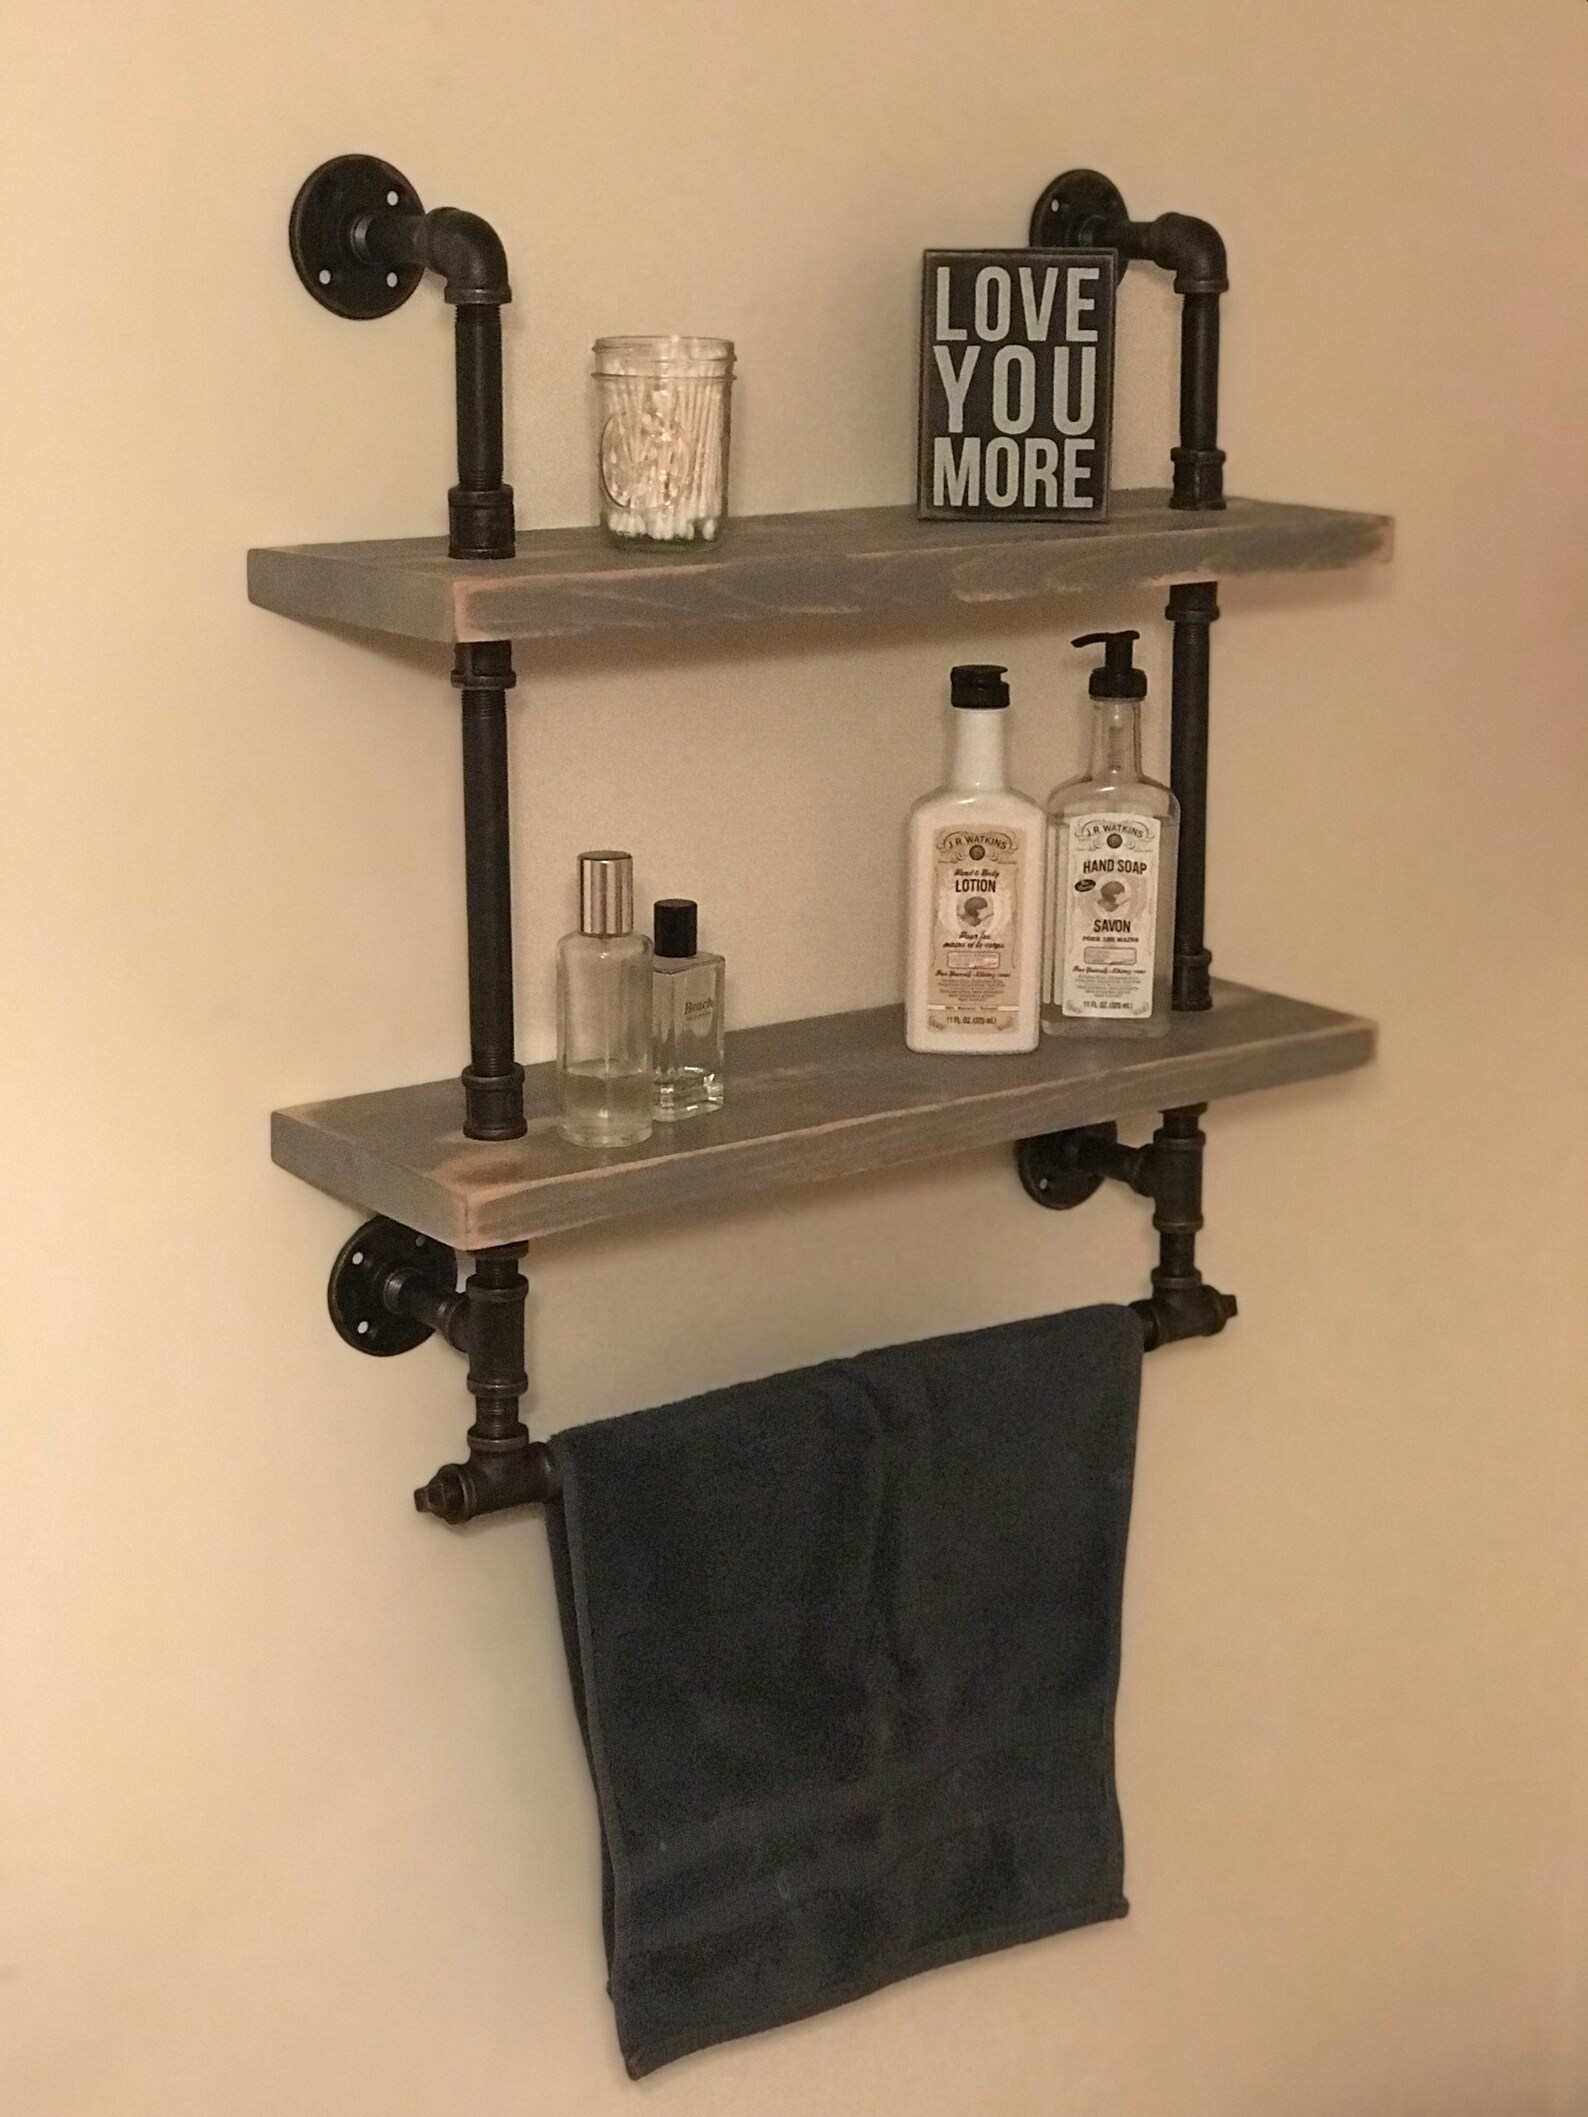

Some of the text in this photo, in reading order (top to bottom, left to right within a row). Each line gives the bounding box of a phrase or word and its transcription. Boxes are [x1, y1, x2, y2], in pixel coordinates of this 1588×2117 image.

[936, 266, 1100, 342] LOVE
[933, 345, 1097, 435] YOU
[933, 437, 1095, 508] MORE
[1102, 824, 1145, 839] WATKINS
[965, 835, 1008, 850] WATKINS
[1083, 859, 1148, 875] HAND SOAP
[955, 879, 997, 893] LOTION
[1093, 919, 1132, 933] SAVON
[684, 997, 713, 1015] Beach
